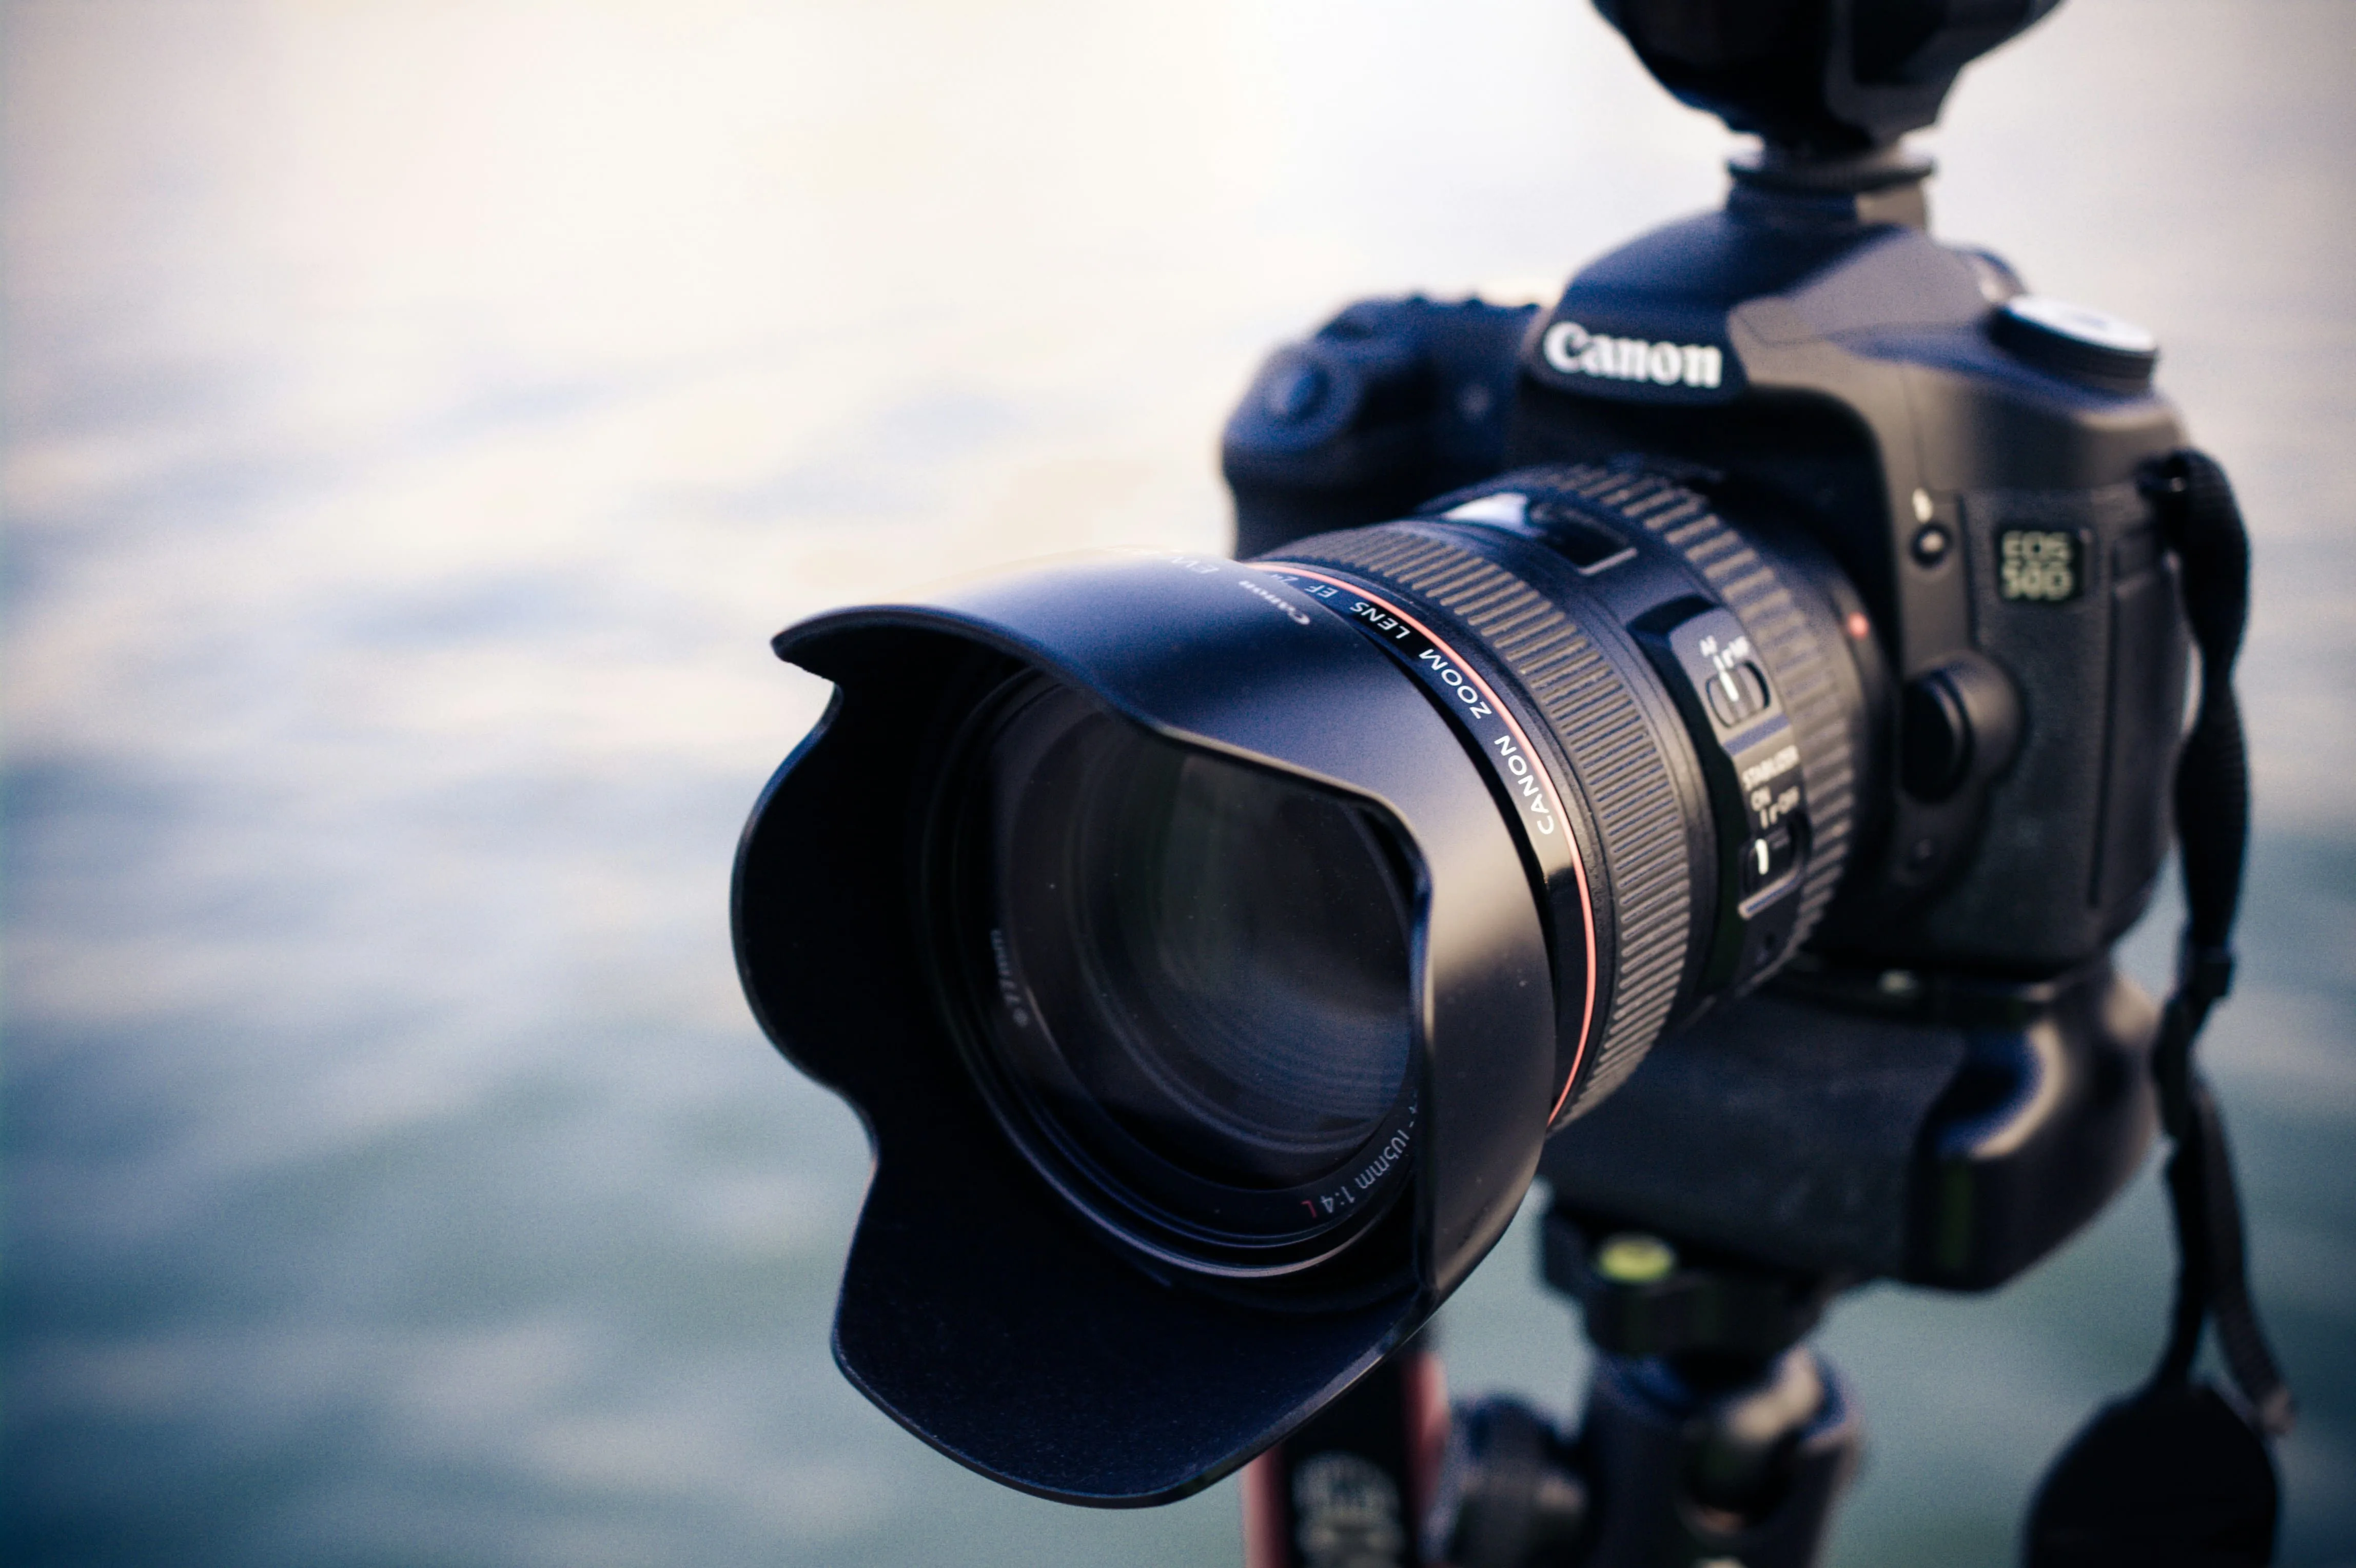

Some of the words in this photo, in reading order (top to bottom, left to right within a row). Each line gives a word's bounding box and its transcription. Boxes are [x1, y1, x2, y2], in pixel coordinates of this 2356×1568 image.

[1543, 321, 1722, 388] Canon
[2002, 531, 2071, 563] EOS
[1238, 580, 1310, 625] Canon
[1304, 584, 1339, 598] EF
[1349, 602, 1411, 639] LENS
[1419, 649, 1492, 719] ZOOM
[1494, 735, 1555, 835] CANON
[1300, 1199, 1318, 1219] L
[1320, 1186, 1356, 1213] 1:4
